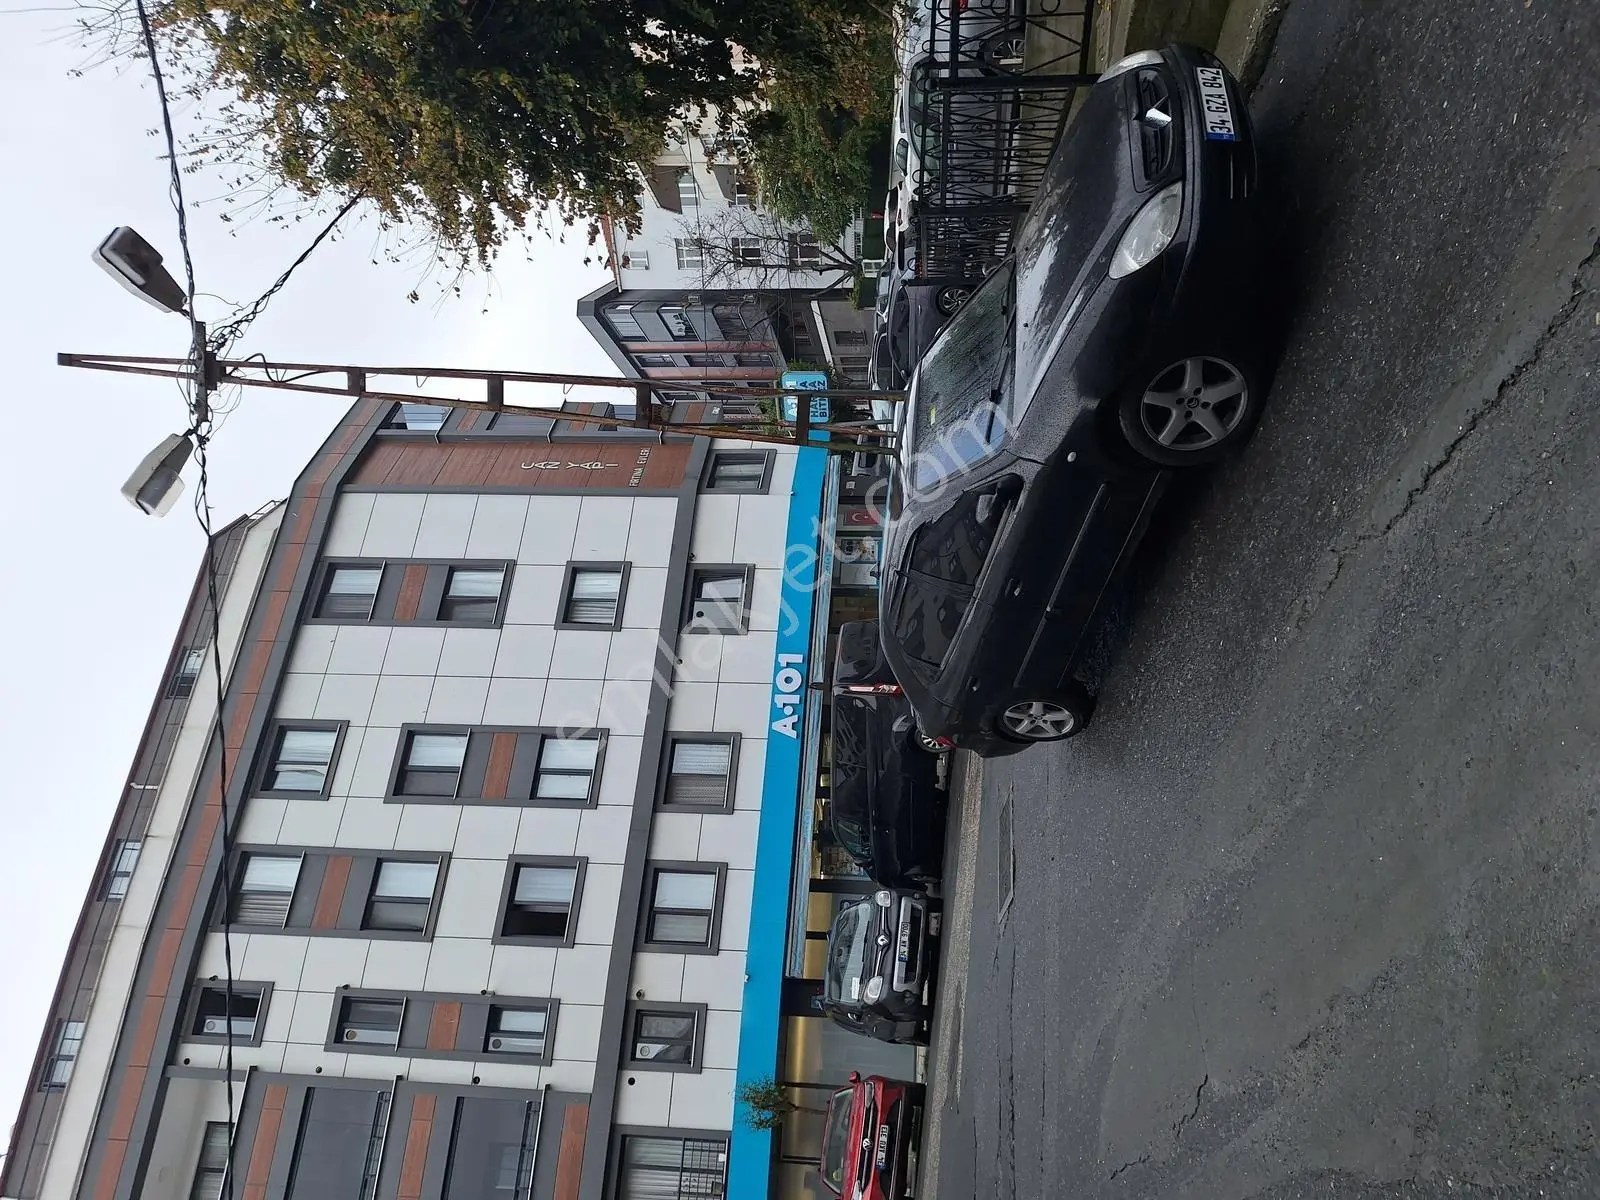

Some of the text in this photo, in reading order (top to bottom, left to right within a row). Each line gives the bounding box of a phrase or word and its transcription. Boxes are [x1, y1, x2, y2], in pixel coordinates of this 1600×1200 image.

[1200, 69, 1222, 88] 842
[1204, 94, 1228, 113] GZA
[1209, 120, 1231, 133] 34
[521, 461, 618, 470] CAN YAPI
